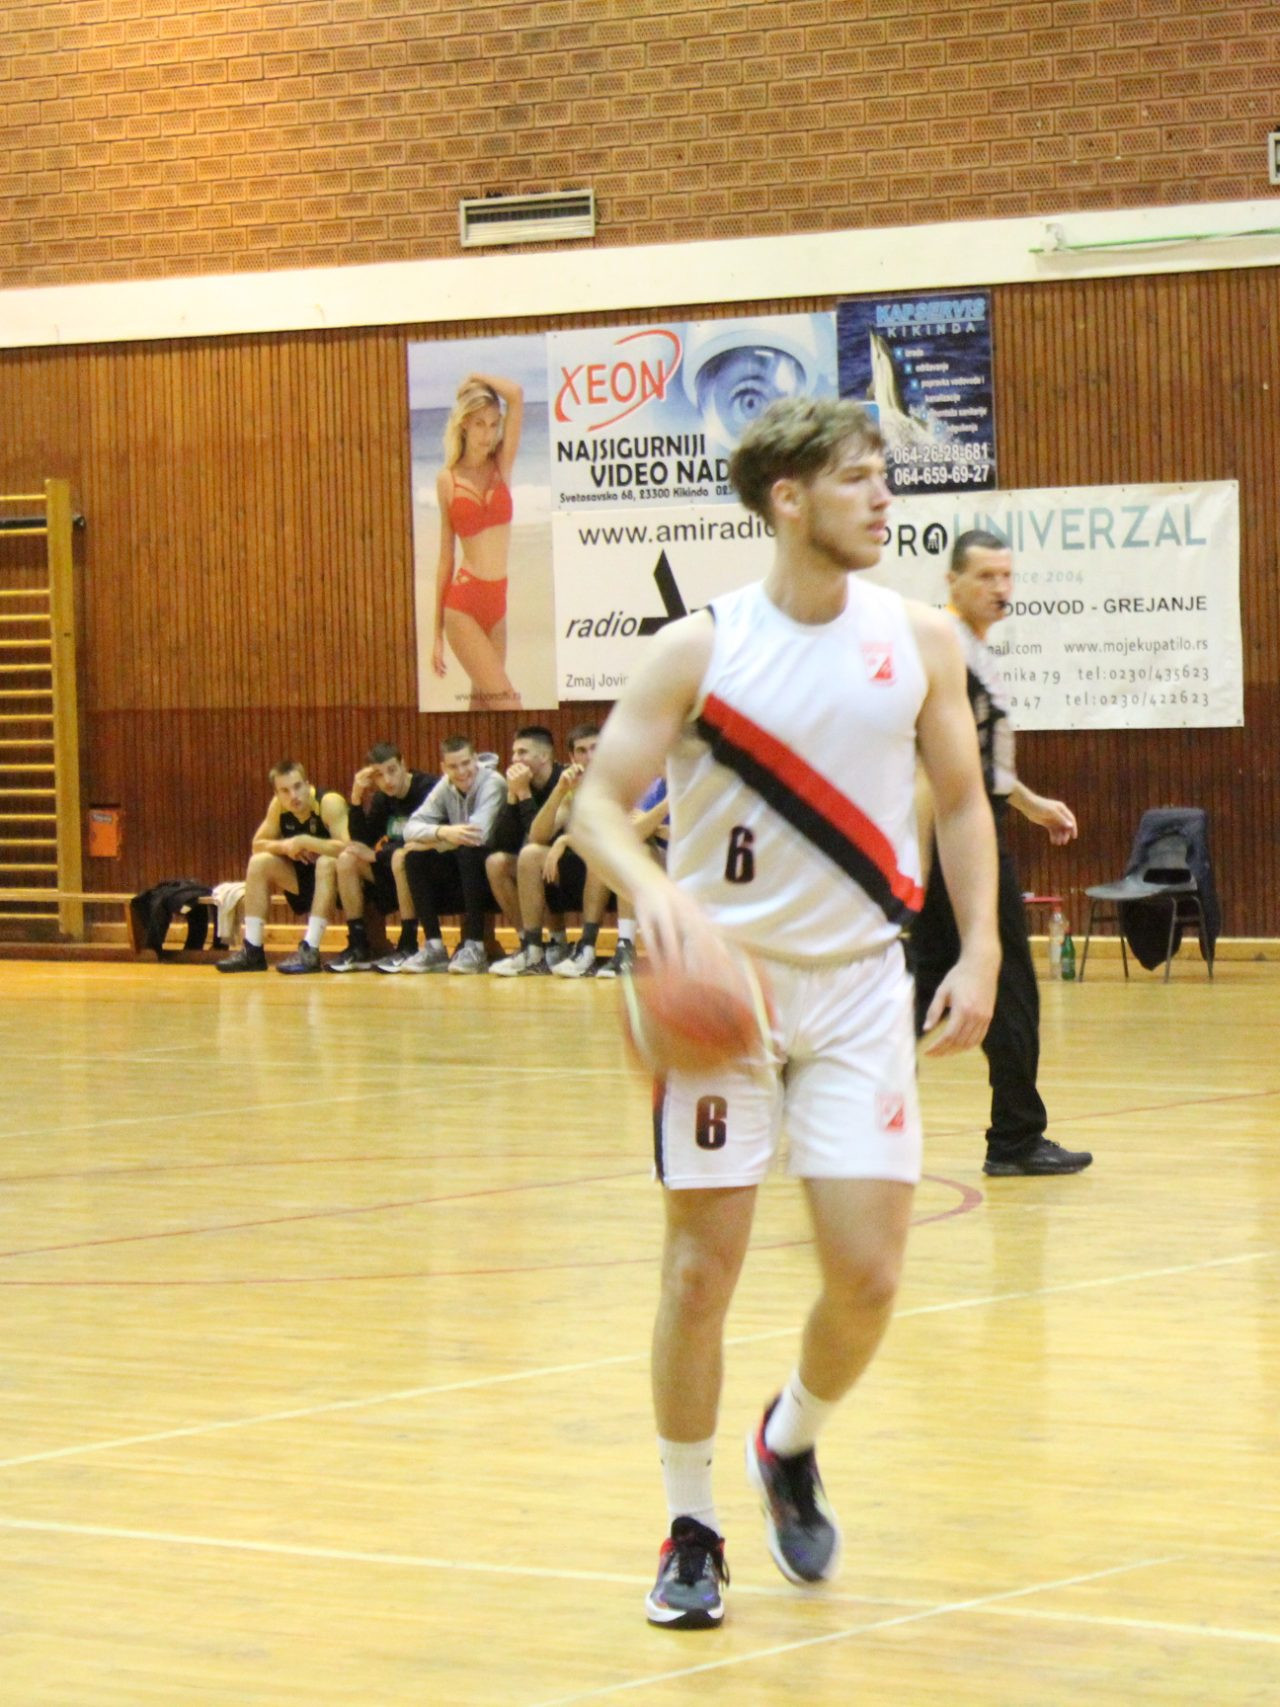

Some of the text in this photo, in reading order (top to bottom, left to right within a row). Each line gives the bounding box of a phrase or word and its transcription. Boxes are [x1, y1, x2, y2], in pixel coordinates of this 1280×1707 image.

[887, 322, 976, 338] KIKINDA
[561, 359, 664, 405] XEON
[557, 434, 706, 463] NAJSIGURNIJI
[894, 443, 988, 463] 064-26-28-681
[591, 457, 731, 488] VIDEO NAD
[894, 465, 990, 486] 064-659-69-27
[579, 516, 778, 545] www.amiradio
[1103, 596, 1208, 614] GREJANJE
[565, 610, 637, 639] radio
[1064, 638, 1209, 656] www.mojekupatilo.rs
[566, 673, 595, 690] Zmaj
[1003, 667, 1036, 682] nika
[1043, 671, 1061, 685] 79
[1024, 696, 1041, 710] 47
[724, 824, 756, 884] 6
[695, 1095, 728, 1150] 6
